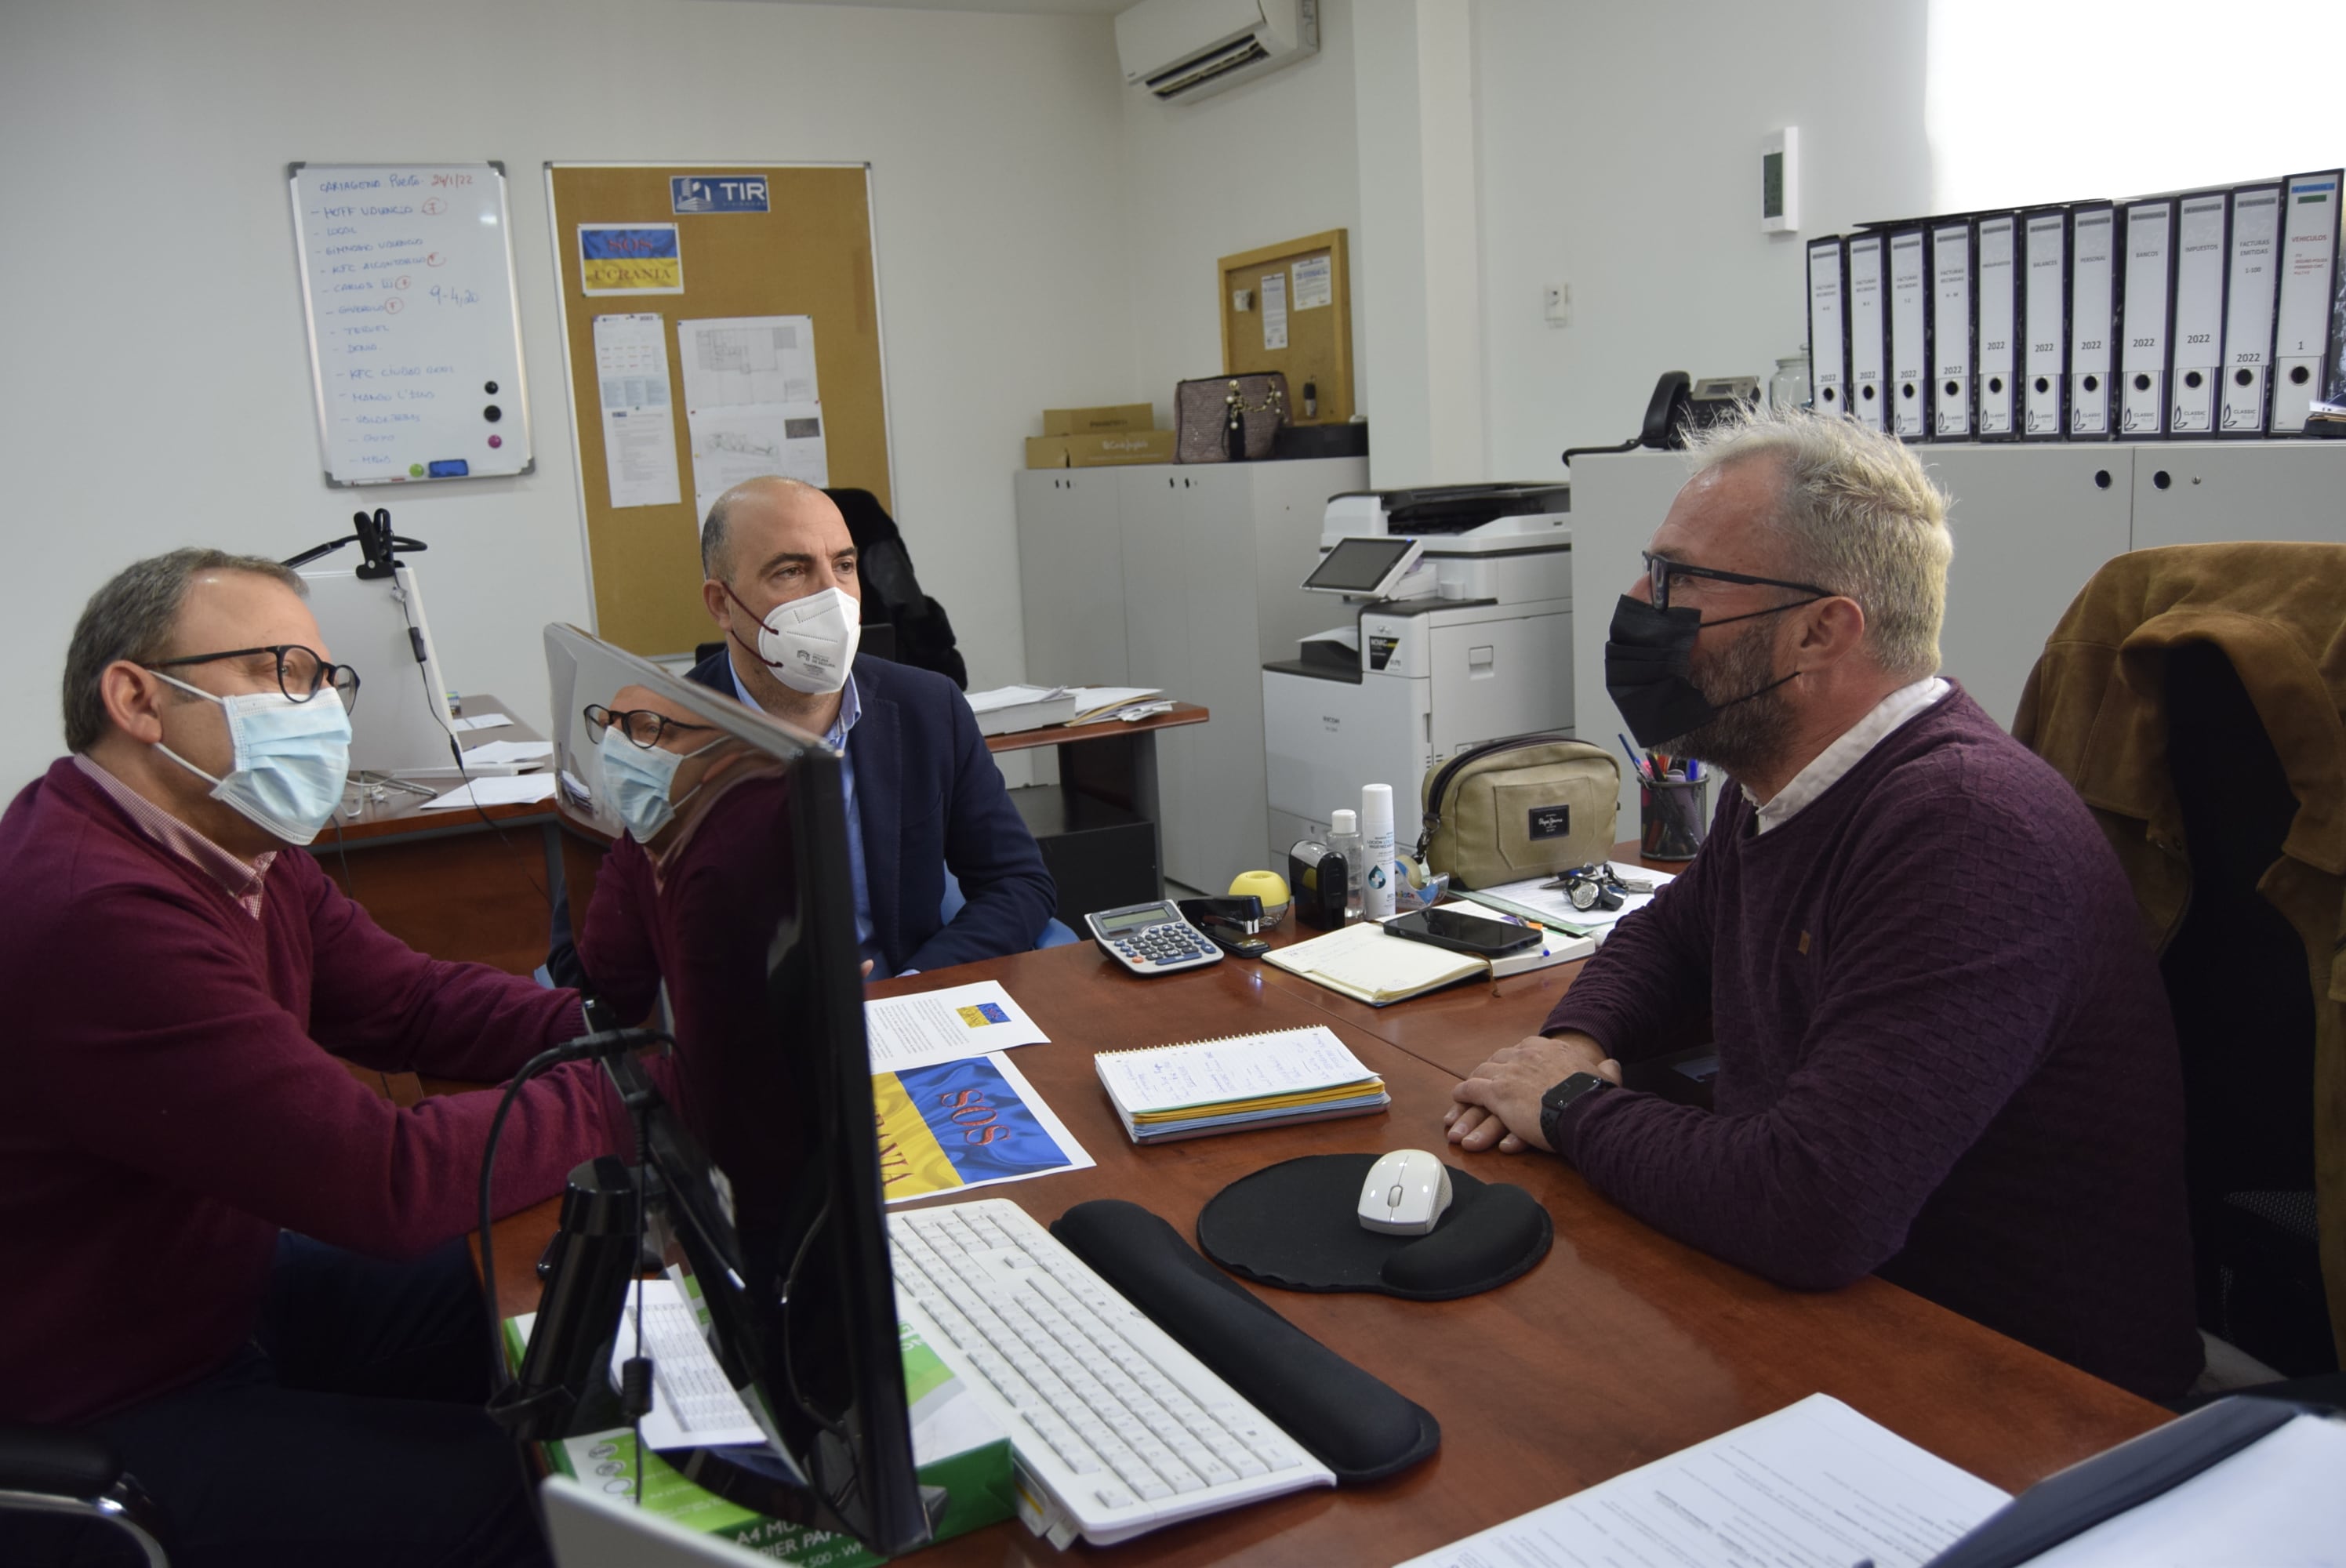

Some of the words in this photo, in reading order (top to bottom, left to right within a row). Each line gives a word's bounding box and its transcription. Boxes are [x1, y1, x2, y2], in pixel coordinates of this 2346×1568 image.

[720, 183, 766, 201] TIR
[608, 238, 652, 252] SOS
[2185, 244, 2218, 252] IMPUESTOS
[2033, 260, 2057, 268] BALANCES
[594, 268, 672, 281] UCRANIA
[2133, 338, 2155, 347] 2022
[2187, 334, 2210, 343] 2022
[1987, 341, 2005, 350] 2022
[2035, 343, 2054, 352] 2022
[2082, 340, 2101, 350] 2022
[2297, 341, 2304, 350] 1
[2237, 353, 2260, 362] 2022
[1859, 371, 1876, 379] 2022
[1901, 370, 1916, 379] 2022
[1944, 366, 1962, 375] 2022
[1821, 374, 1836, 383] 2022
[940, 1089, 1011, 1146] SOS
[808, 1552, 833, 1568] 500
